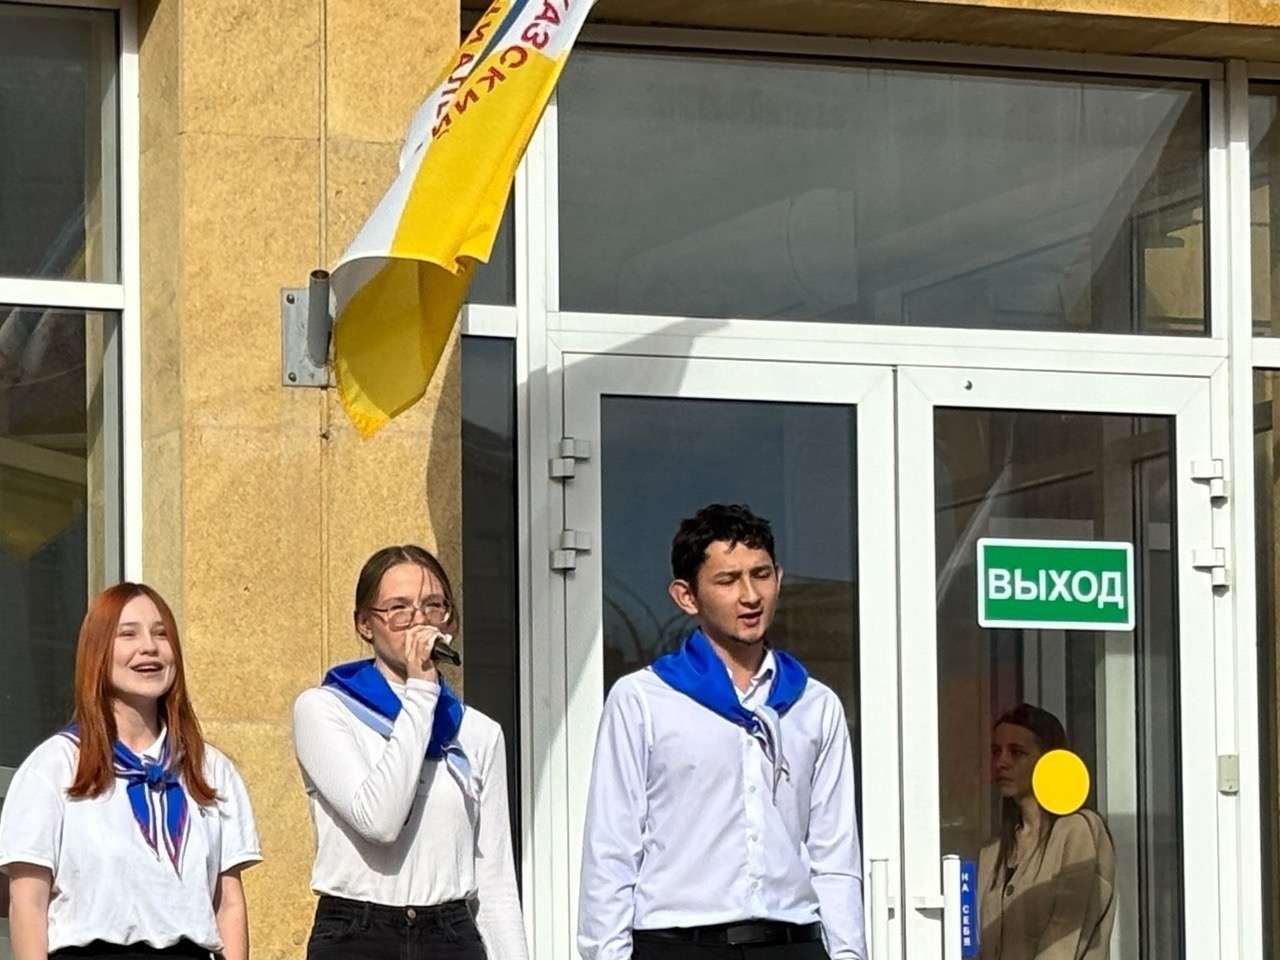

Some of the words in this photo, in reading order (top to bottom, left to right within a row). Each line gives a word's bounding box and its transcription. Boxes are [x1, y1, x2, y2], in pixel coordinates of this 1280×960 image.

[987, 568, 1124, 609] ВЫХОД
[961, 871, 969, 892] НА
[962, 905, 971, 946] СЕБЯ
